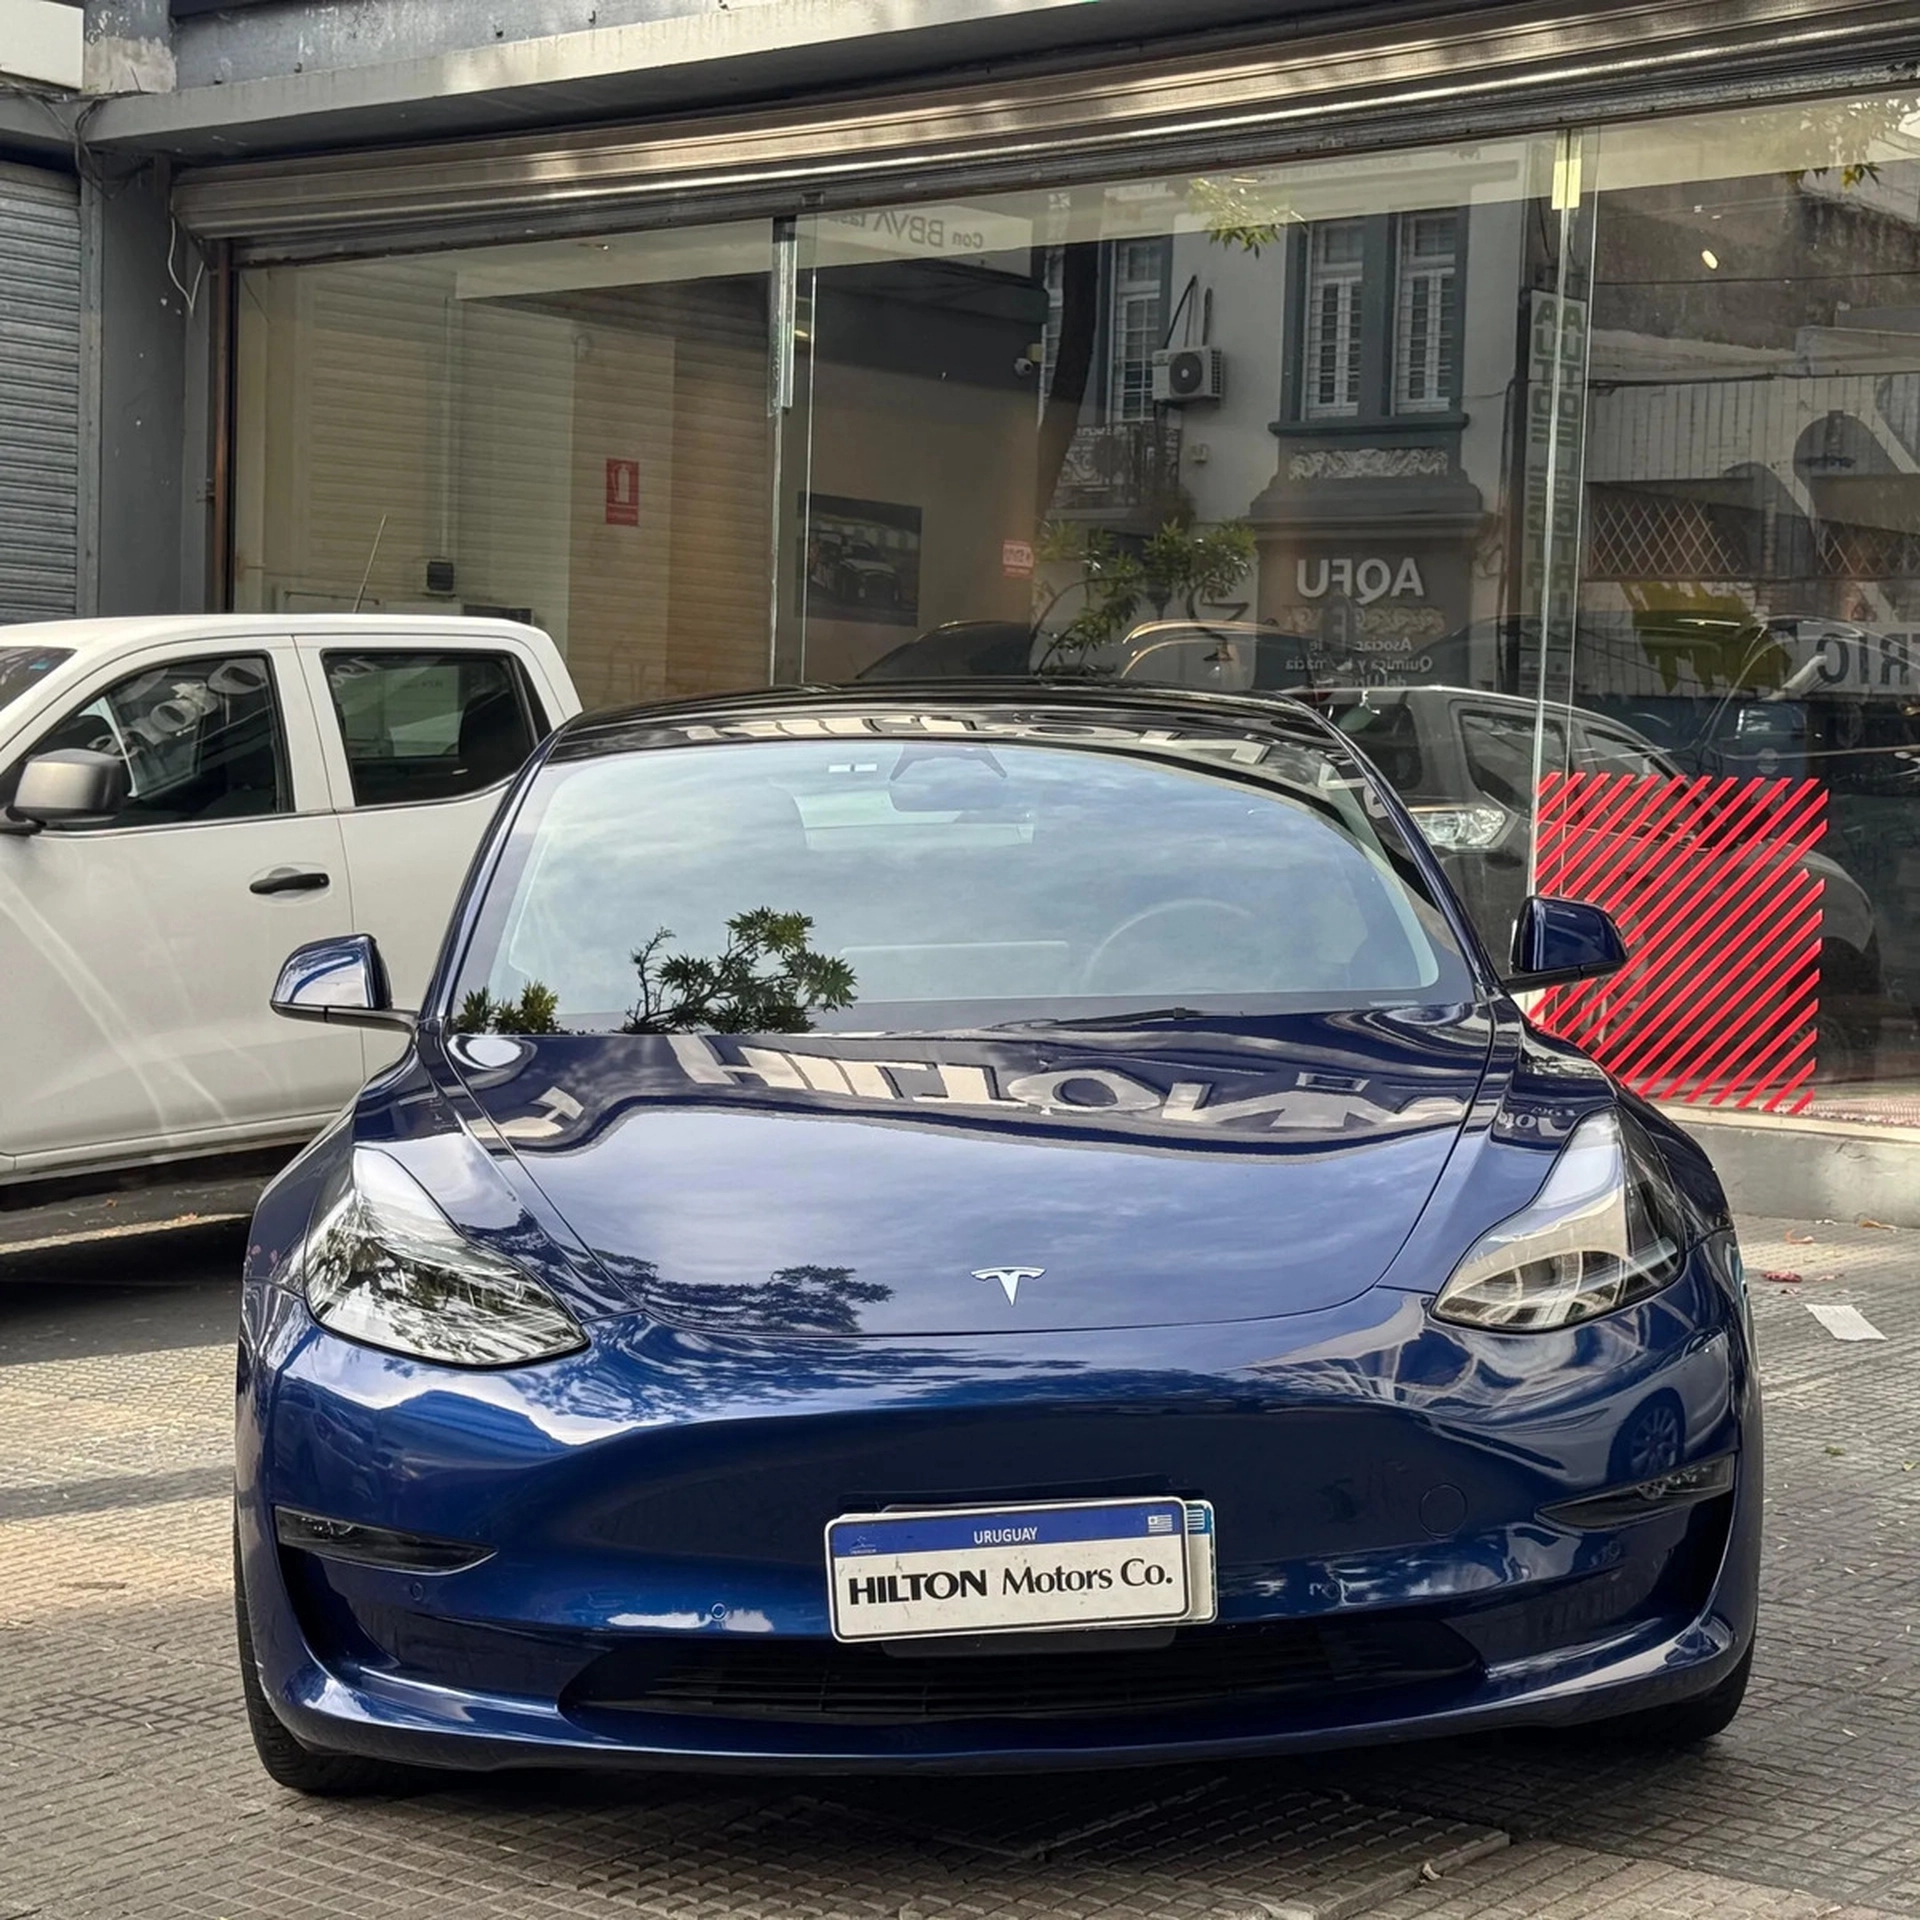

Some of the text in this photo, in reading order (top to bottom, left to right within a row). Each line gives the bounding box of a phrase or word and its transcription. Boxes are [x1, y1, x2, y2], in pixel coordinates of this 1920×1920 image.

[972, 1526, 1039, 1545] URUGUAY
[848, 1557, 1174, 1606] HILTON Motors Co.
